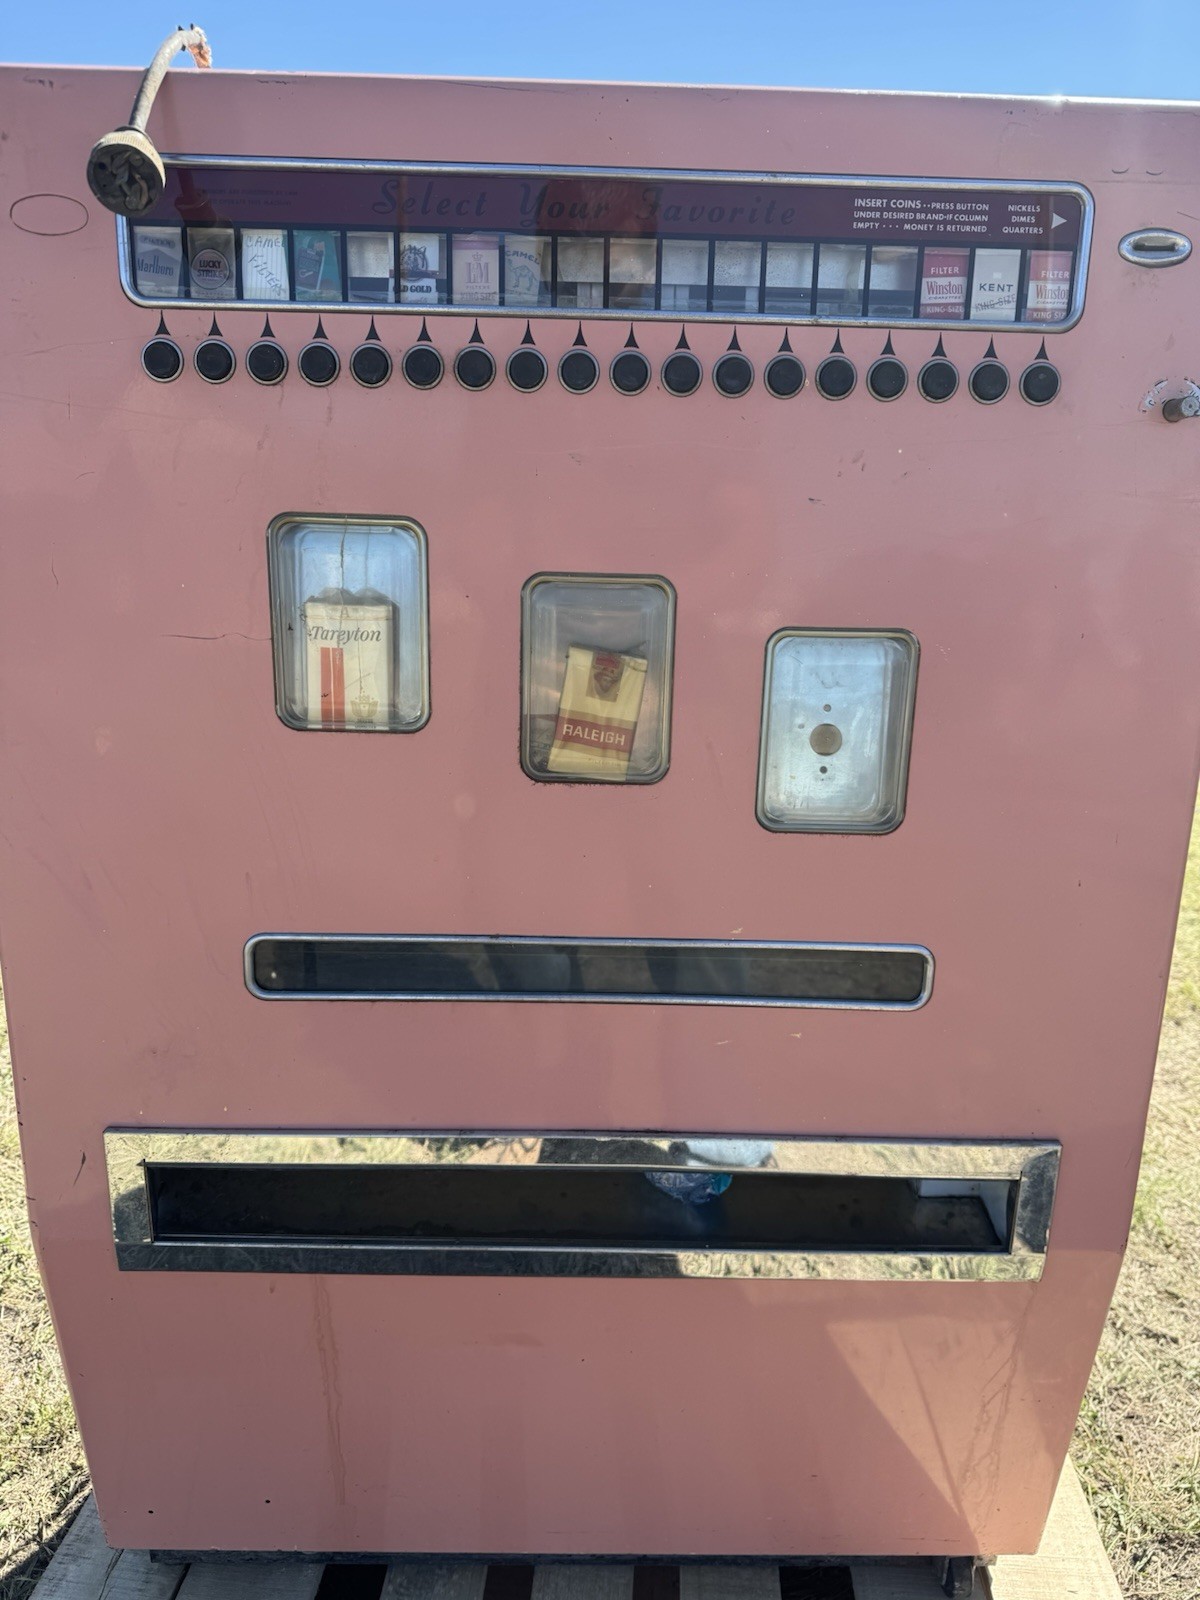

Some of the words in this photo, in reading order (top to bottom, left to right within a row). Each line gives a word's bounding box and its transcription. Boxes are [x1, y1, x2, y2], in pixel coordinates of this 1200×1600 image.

[371, 178, 488, 216] Select
[519, 182, 610, 228] Your
[635, 186, 797, 226] Favorite
[854, 198, 888, 208] INSERT
[890, 199, 922, 209] COINS
[956, 203, 990, 211] BUTTON
[1007, 204, 1041, 213] NICKELS
[853, 211, 881, 219] UNDER
[882, 211, 915, 220] DESIRED
[954, 213, 989, 222] COLUMN
[1011, 215, 1036, 223] DIMES
[852, 221, 880, 229] EMPTY
[903, 223, 934, 231] MONEY
[946, 225, 988, 233] RETURNED
[1002, 226, 1044, 234] QUARTERS
[504, 249, 540, 266] CAMEL
[137, 255, 174, 276] Marlboro
[199, 259, 222, 269] LUCKY
[197, 269, 223, 277] STRIKE
[930, 266, 960, 275] FILTER
[1041, 270, 1070, 279] FILTER
[410, 285, 432, 294] GOLD
[926, 280, 963, 295] Winston
[978, 282, 1014, 292] KENT
[1036, 284, 1069, 300] Winsto
[926, 305, 946, 313] KING
[1032, 311, 1052, 319] KING
[311, 626, 382, 645] Tareyton
[563, 723, 626, 746] RALEIGH
